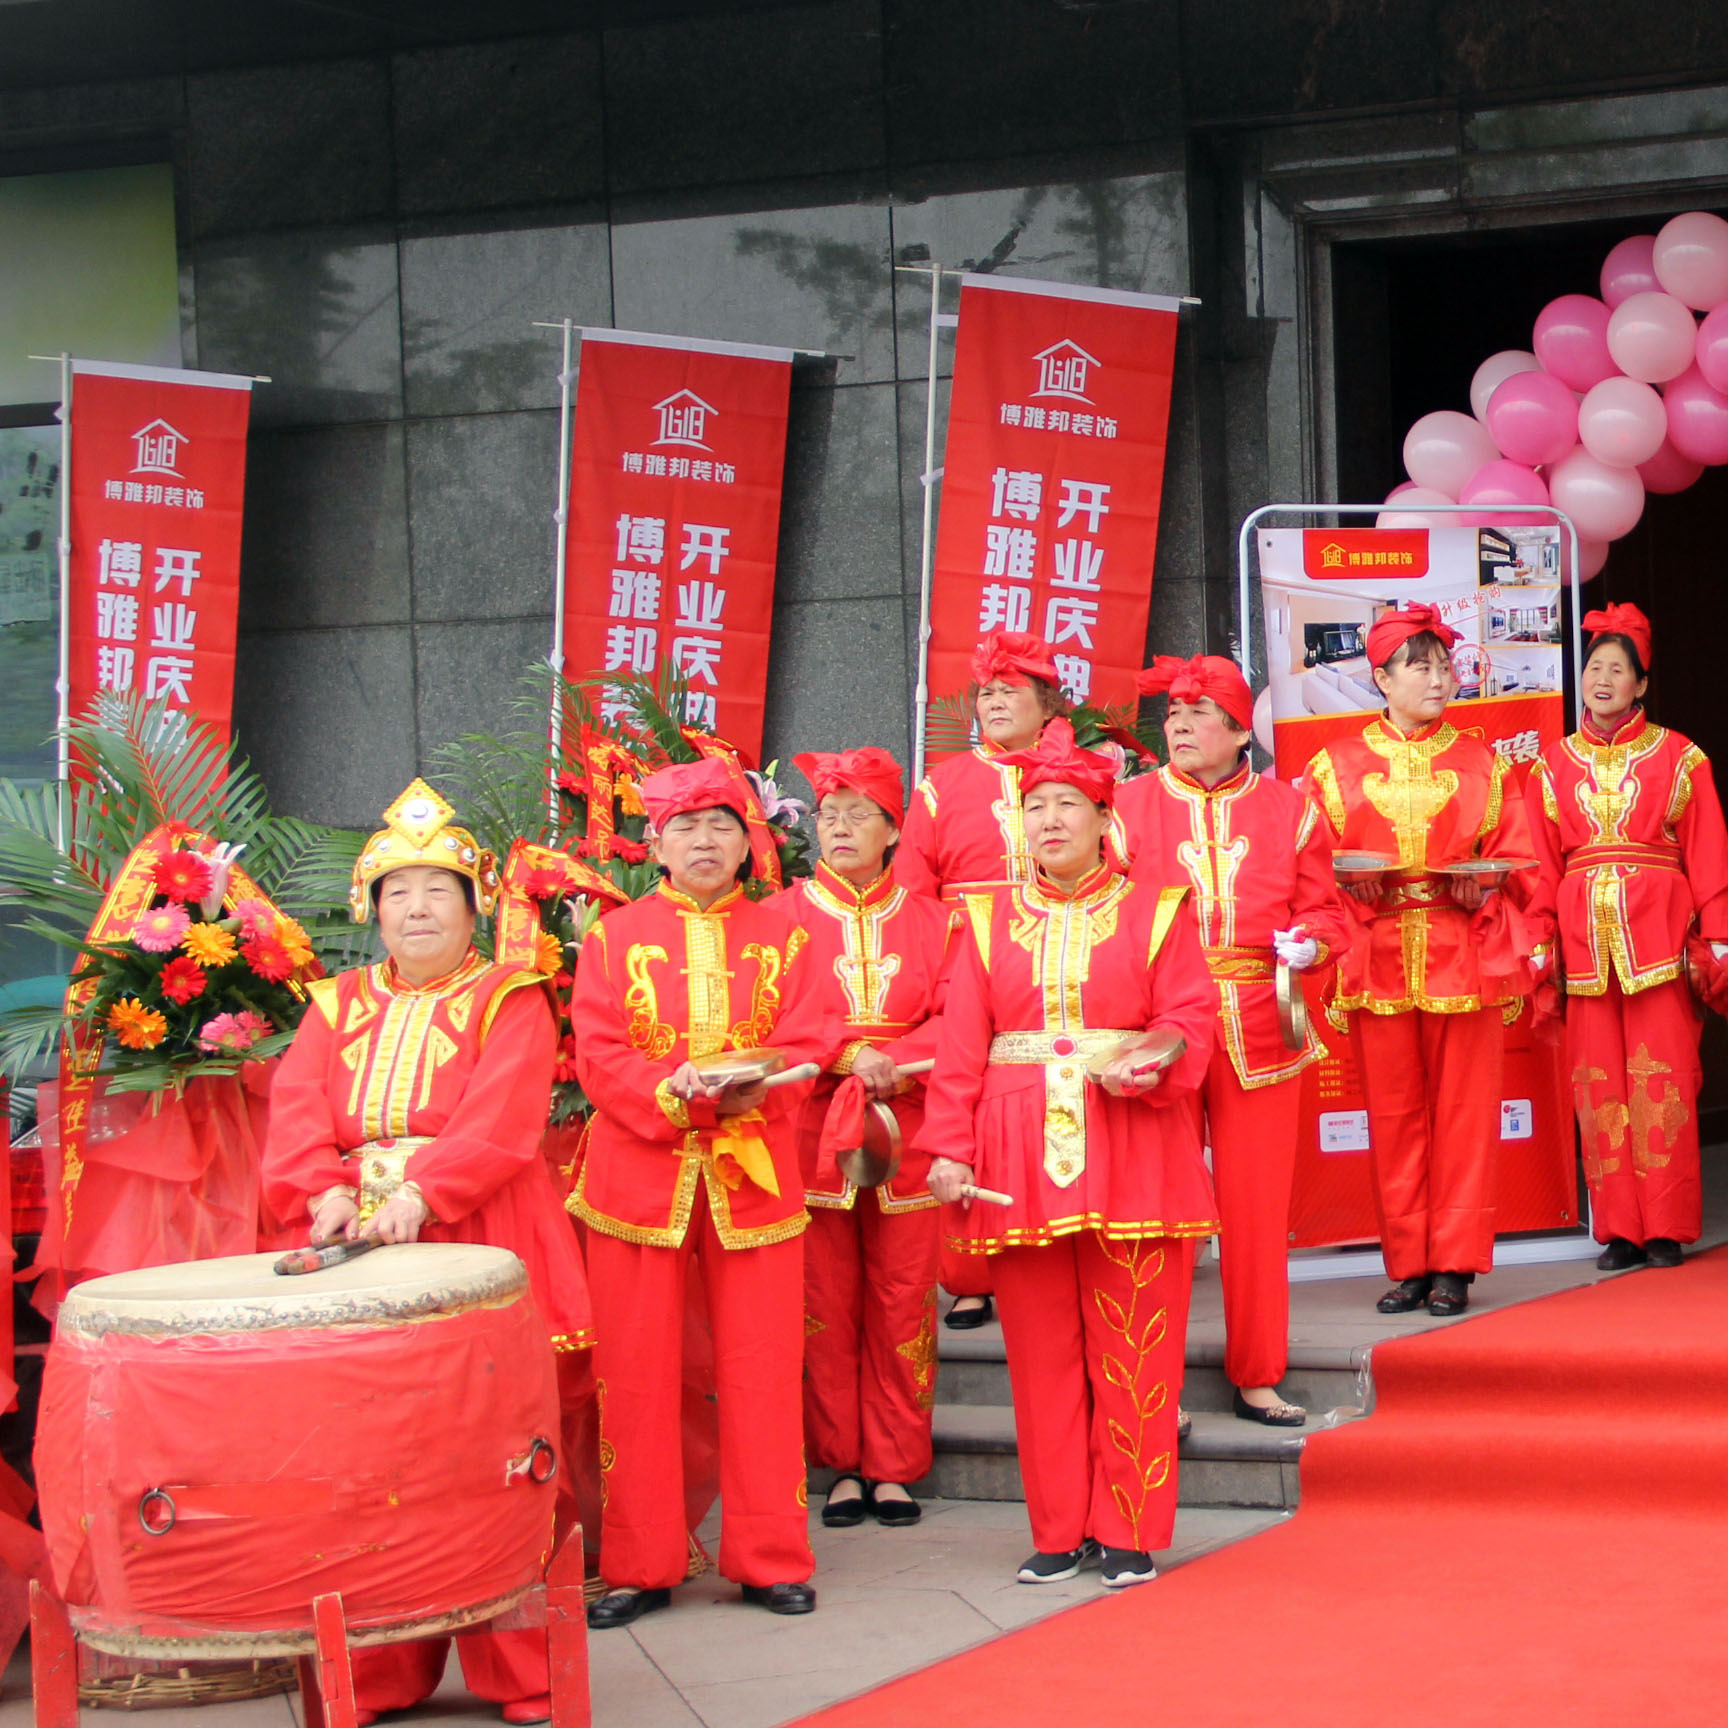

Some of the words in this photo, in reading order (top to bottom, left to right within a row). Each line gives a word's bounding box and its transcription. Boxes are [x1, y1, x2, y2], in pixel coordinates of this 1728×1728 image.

[1000, 403, 1118, 439] 博雅邦装饰
[622, 452, 736, 484] 博雅邦装饰
[105, 480, 204, 509] 博雅邦装饰
[977, 467, 1043, 650] 博雅邦
[1349, 552, 1413, 566] 博雅邦装饰
[1044, 479, 1111, 706] 开业庆典
[97, 539, 142, 738] 博雅邦
